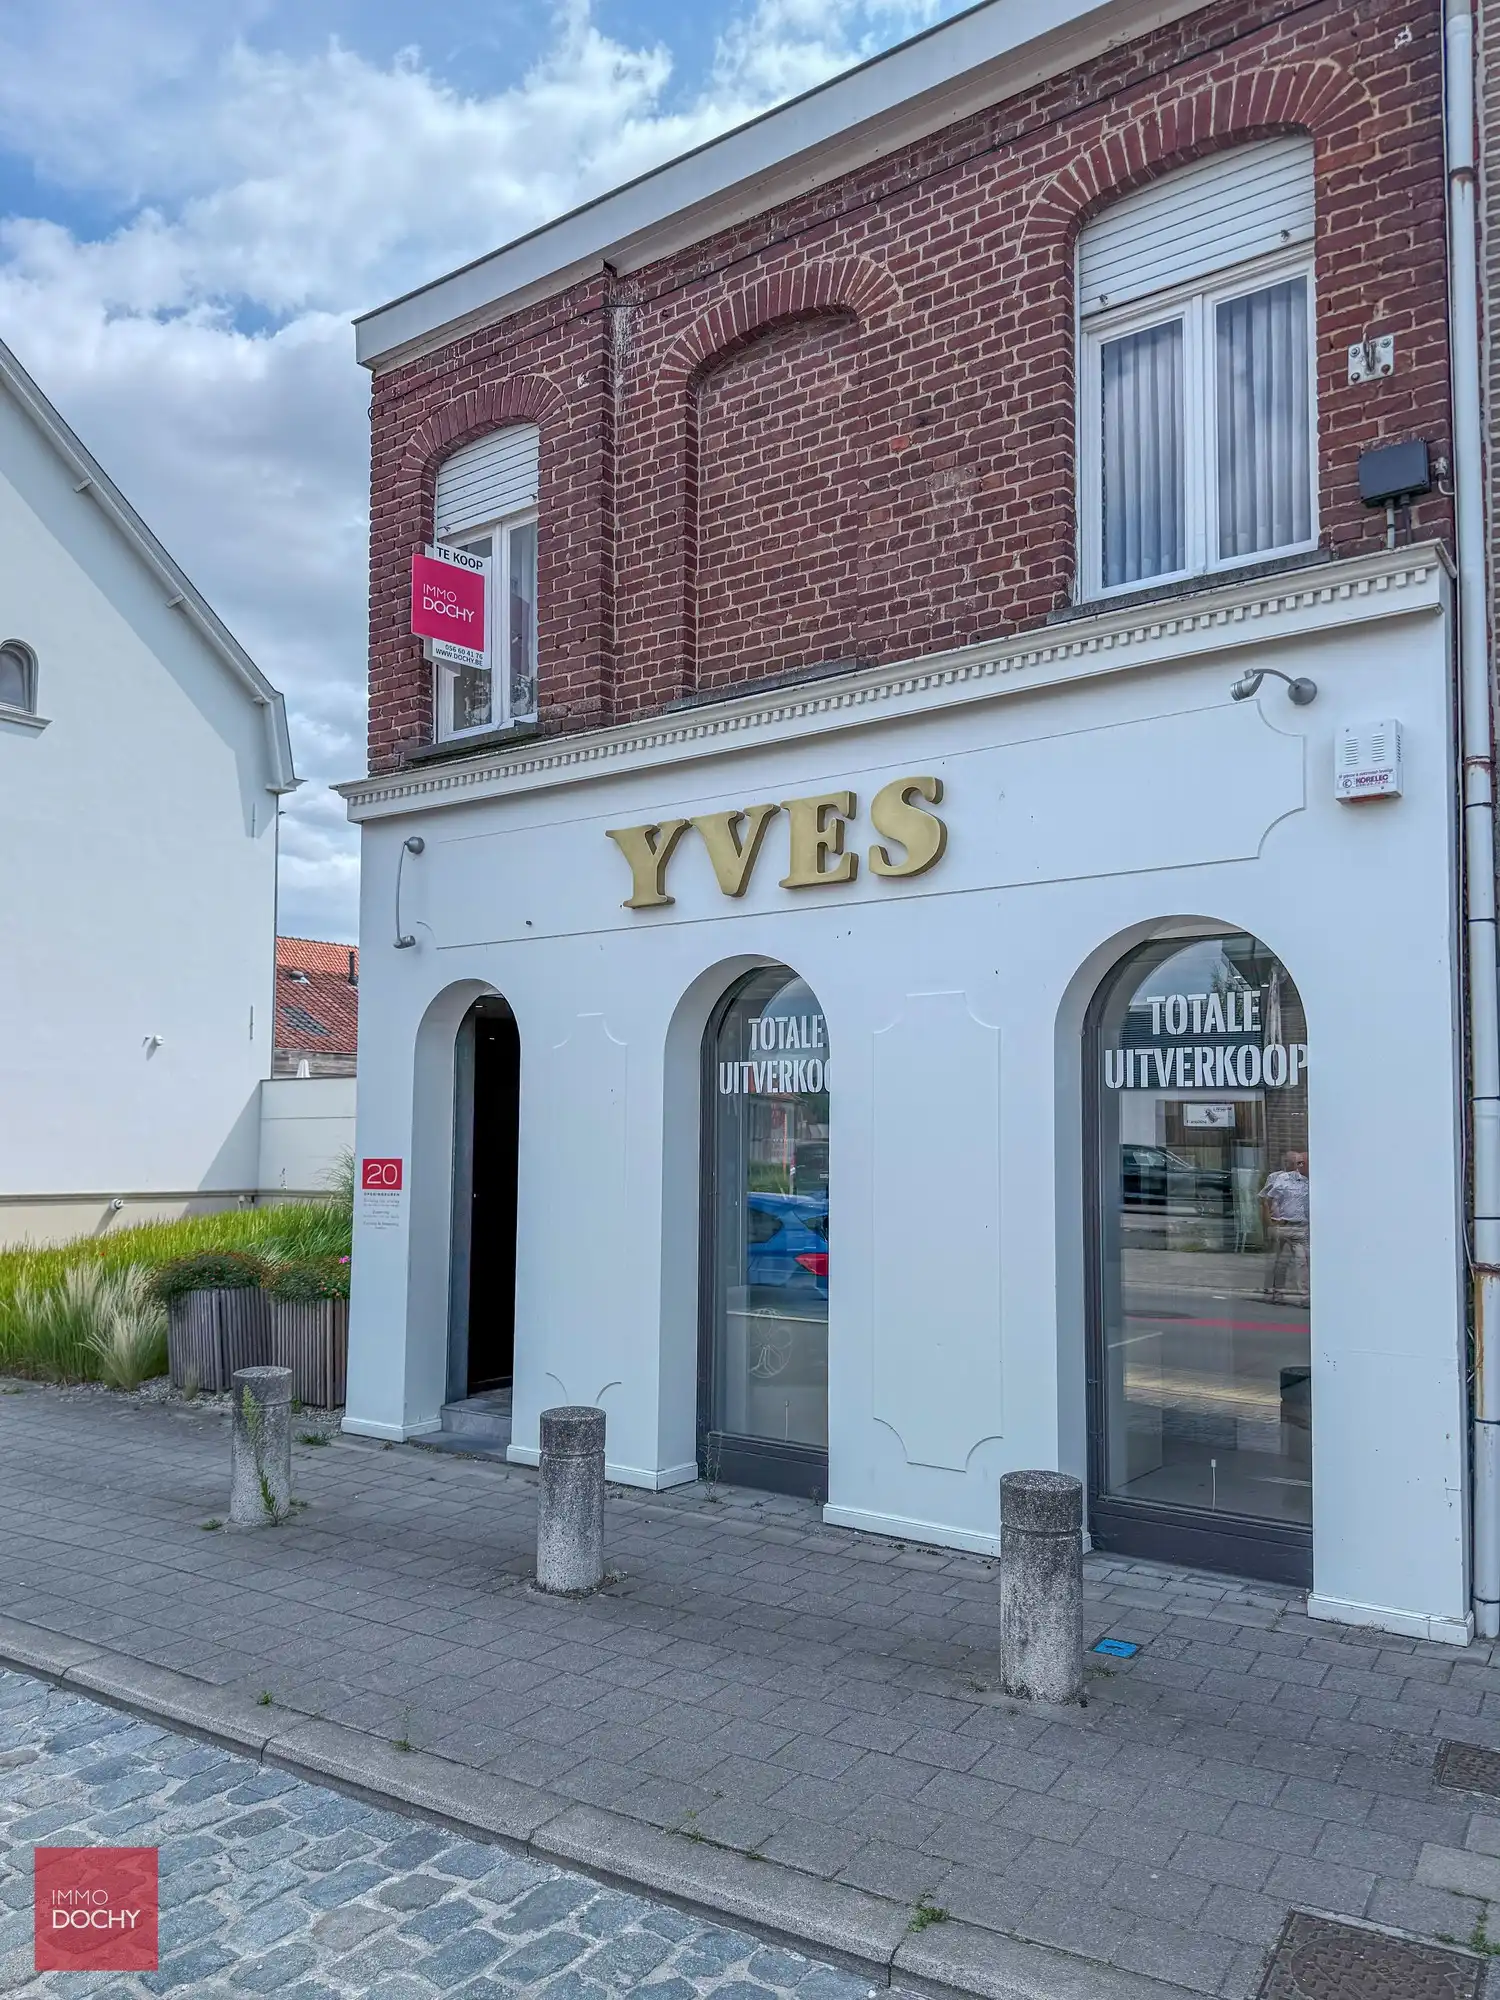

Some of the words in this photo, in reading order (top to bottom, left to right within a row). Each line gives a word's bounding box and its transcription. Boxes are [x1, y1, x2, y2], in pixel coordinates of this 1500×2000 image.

[437, 546, 450, 560] TE
[453, 552, 483, 570] KOOP
[423, 583, 457, 603] IMMO
[423, 597, 475, 623] DOCHY
[436, 648, 483, 667] WWW.DOCHY.BE
[445, 644, 457, 653] 056
[458, 647, 466, 655] 60
[467, 650, 474, 658] 41
[605, 776, 948, 910] YVES
[1147, 990, 1261, 1035] TOTALE
[748, 1014, 824, 1051] TOTALE
[1105, 1044, 1308, 1089] UITVERKOOP
[367, 1163, 398, 1185] 20
